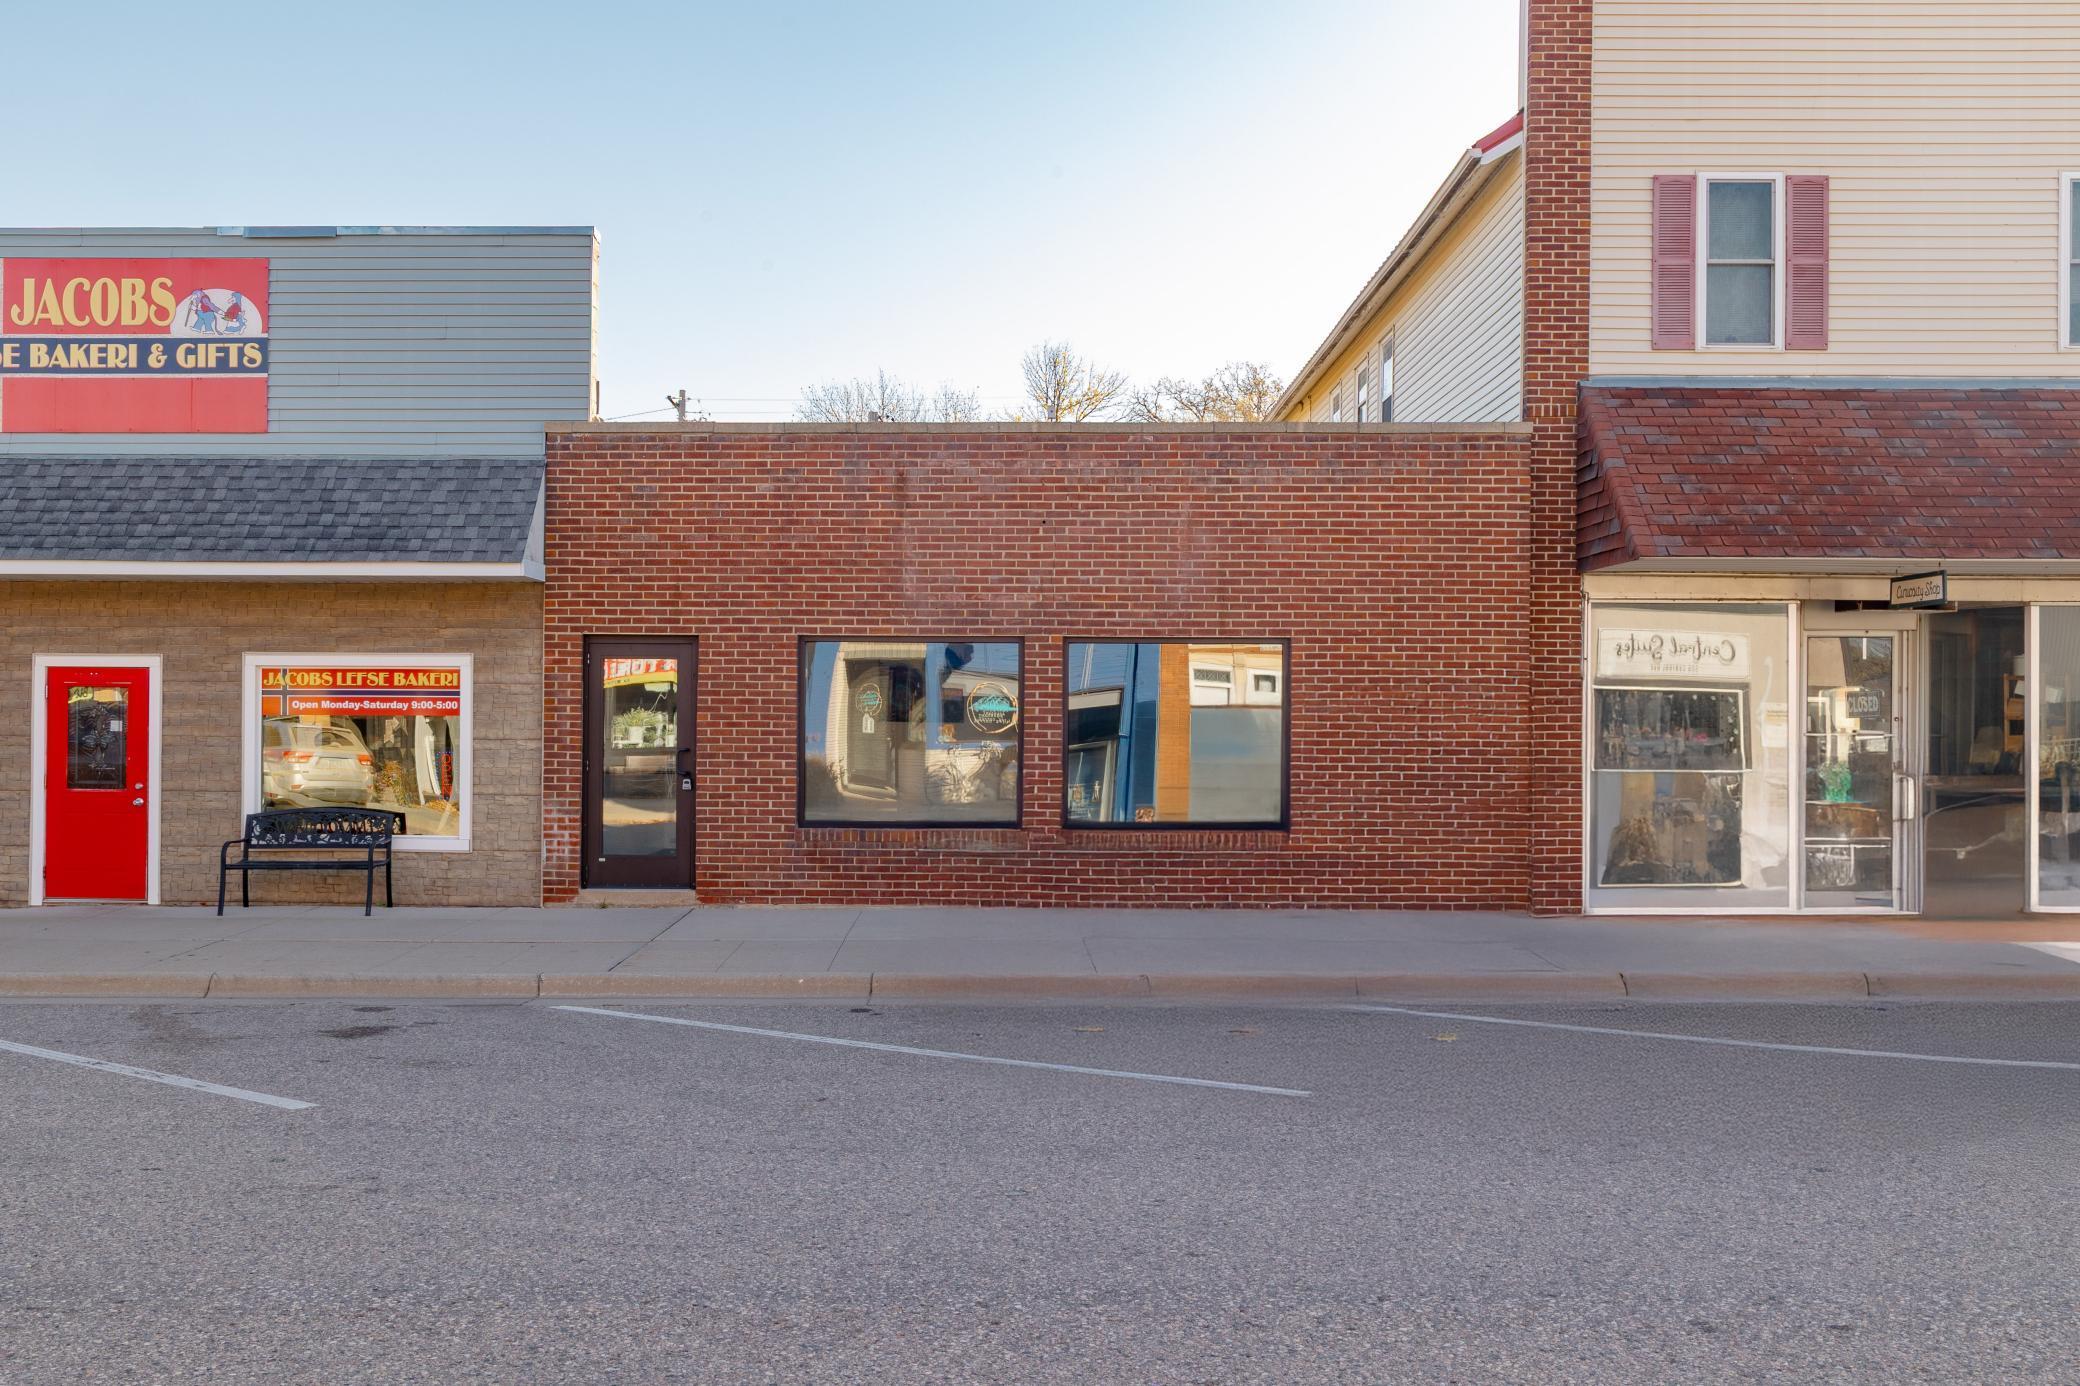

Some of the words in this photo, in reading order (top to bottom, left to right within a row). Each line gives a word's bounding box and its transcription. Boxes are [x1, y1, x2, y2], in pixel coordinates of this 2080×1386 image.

[10, 277, 177, 328] JACOBS
[29, 343, 138, 369] BAKERI
[147, 343, 168, 369] &
[176, 342, 263, 369] GIFTS
[1924, 580, 1941, 597] Shop
[263, 672, 333, 687] JACOBS
[336, 672, 390, 687] LEFSE
[393, 672, 459, 687] BAKERI
[291, 700, 319, 710] Open
[321, 700, 409, 711] Monday-Saturday
[411, 700, 458, 710] 9:00-5:00
[1847, 695, 1879, 712] CLOSED
